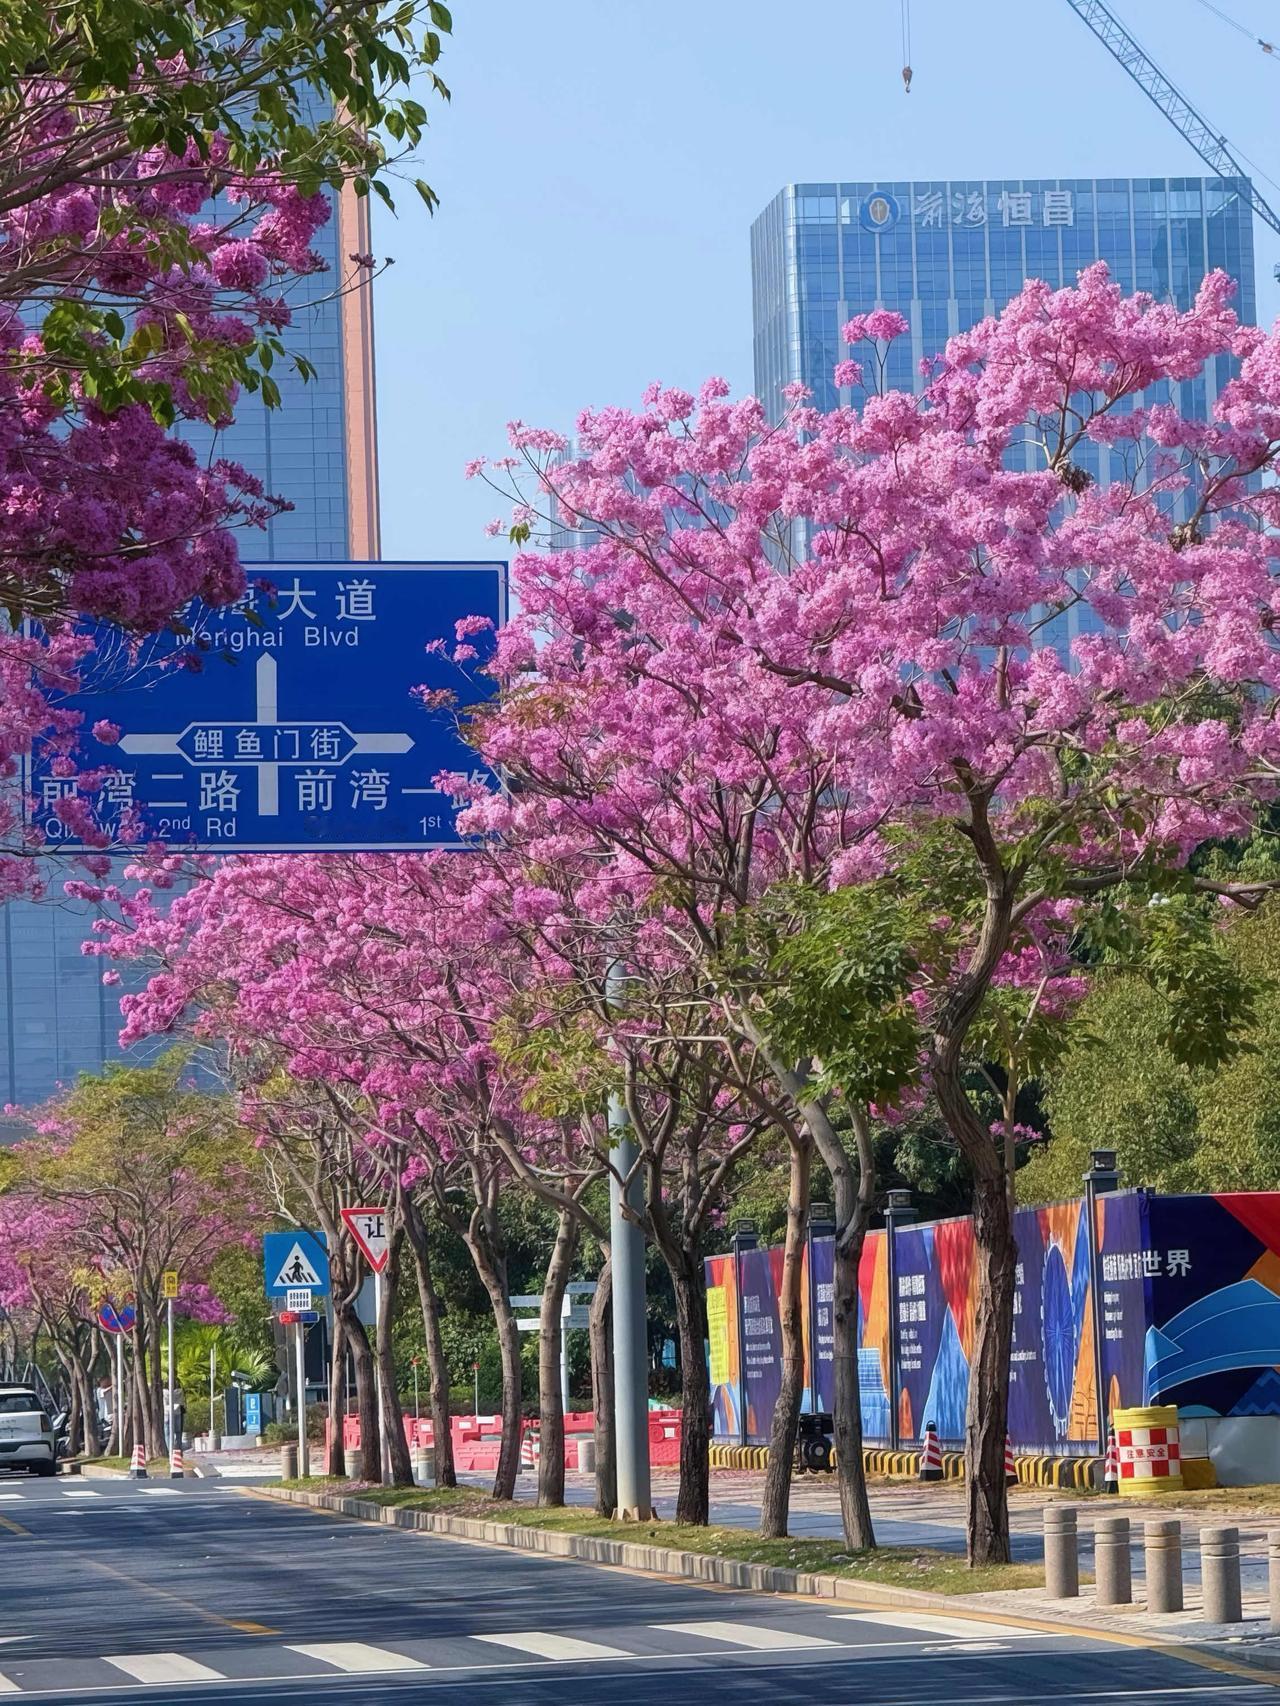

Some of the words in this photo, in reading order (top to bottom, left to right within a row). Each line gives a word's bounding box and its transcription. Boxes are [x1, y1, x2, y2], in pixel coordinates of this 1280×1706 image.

[914, 190, 1075, 229] 前海恒昌
[172, 577, 377, 621] 大道
[304, 626, 359, 647] Blvd
[193, 728, 342, 760] 鲤鱼门街
[38, 768, 241, 813] 前湾二路
[158, 815, 191, 838] 2nd
[206, 817, 237, 838] Rd
[419, 816, 441, 836] 1st
[364, 1215, 386, 1239] 让
